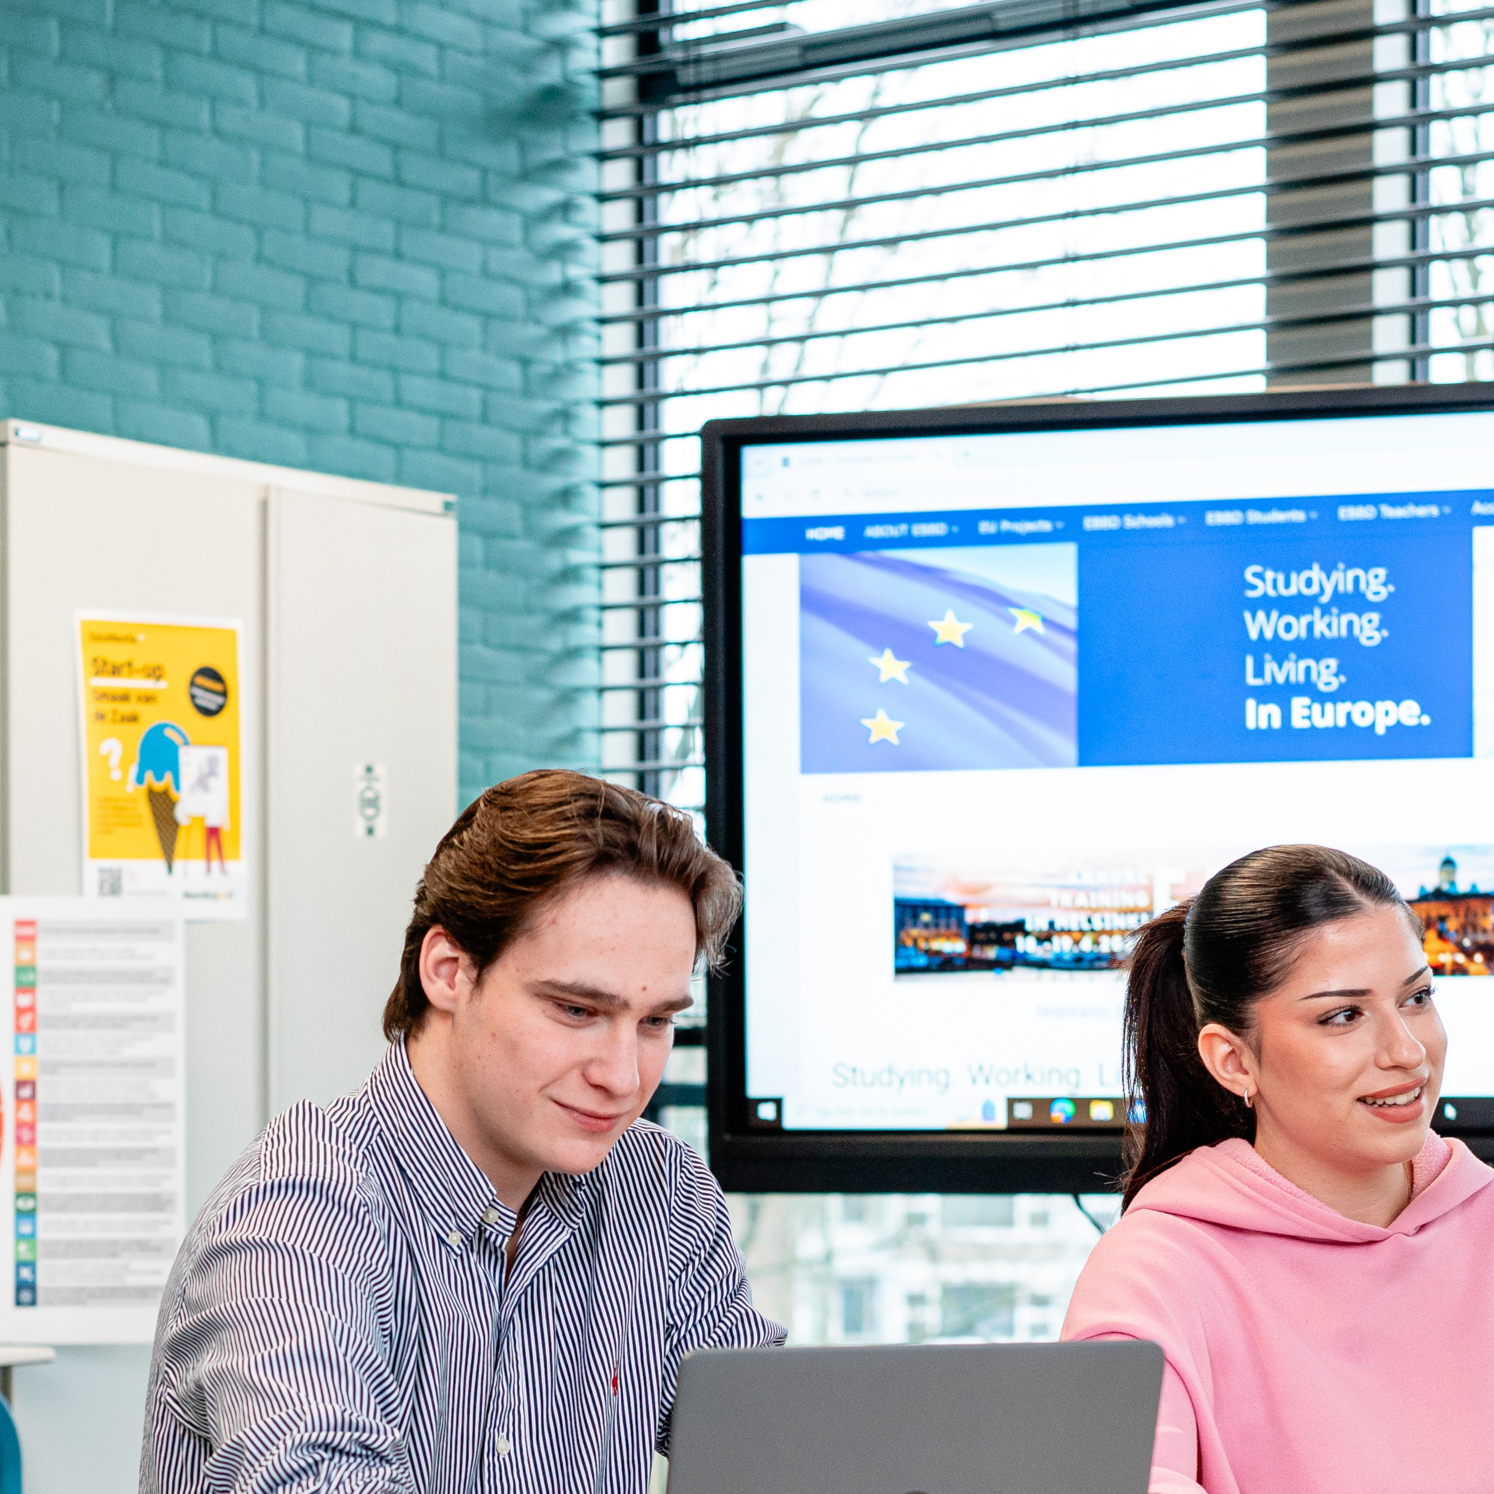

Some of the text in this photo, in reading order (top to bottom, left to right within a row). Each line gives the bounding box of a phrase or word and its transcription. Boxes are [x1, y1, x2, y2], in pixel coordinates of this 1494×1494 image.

[1122, 512, 1175, 529] Schools
[1245, 508, 1307, 524] Students
[1378, 503, 1440, 519] Teachers
[805, 525, 846, 541] HOME
[863, 523, 908, 540] ABOUT
[978, 518, 1054, 536] EU Projects
[1244, 561, 1396, 604] Studying.
[1243, 605, 1390, 647] Working.
[91, 656, 164, 684] Start-up
[1245, 652, 1347, 693] Living.
[1245, 696, 1432, 736] In Europe.
[1048, 889, 1150, 908] TRAINING
[832, 1062, 957, 1094] Studying.
[966, 1062, 1089, 1095] Working.
